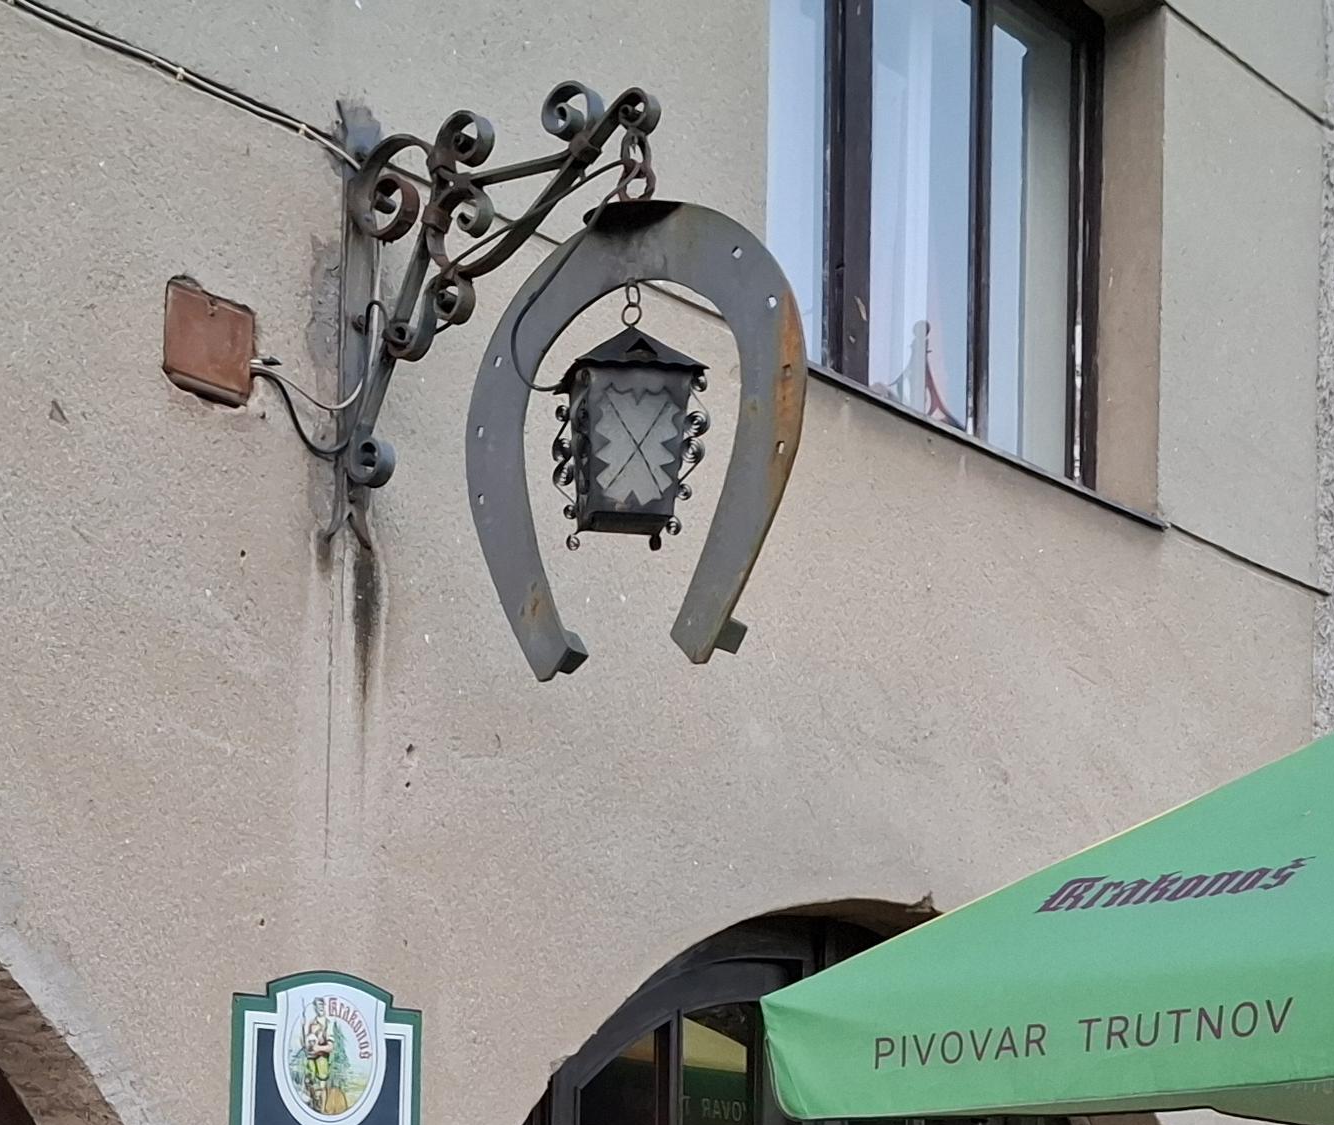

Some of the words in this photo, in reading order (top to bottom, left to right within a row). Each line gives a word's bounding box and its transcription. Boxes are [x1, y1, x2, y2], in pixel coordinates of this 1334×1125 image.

[1034, 856, 1316, 914] Krakonoš
[873, 1022, 1048, 1070] PIVOVAR
[1077, 996, 1295, 1053] TRUTNOV
